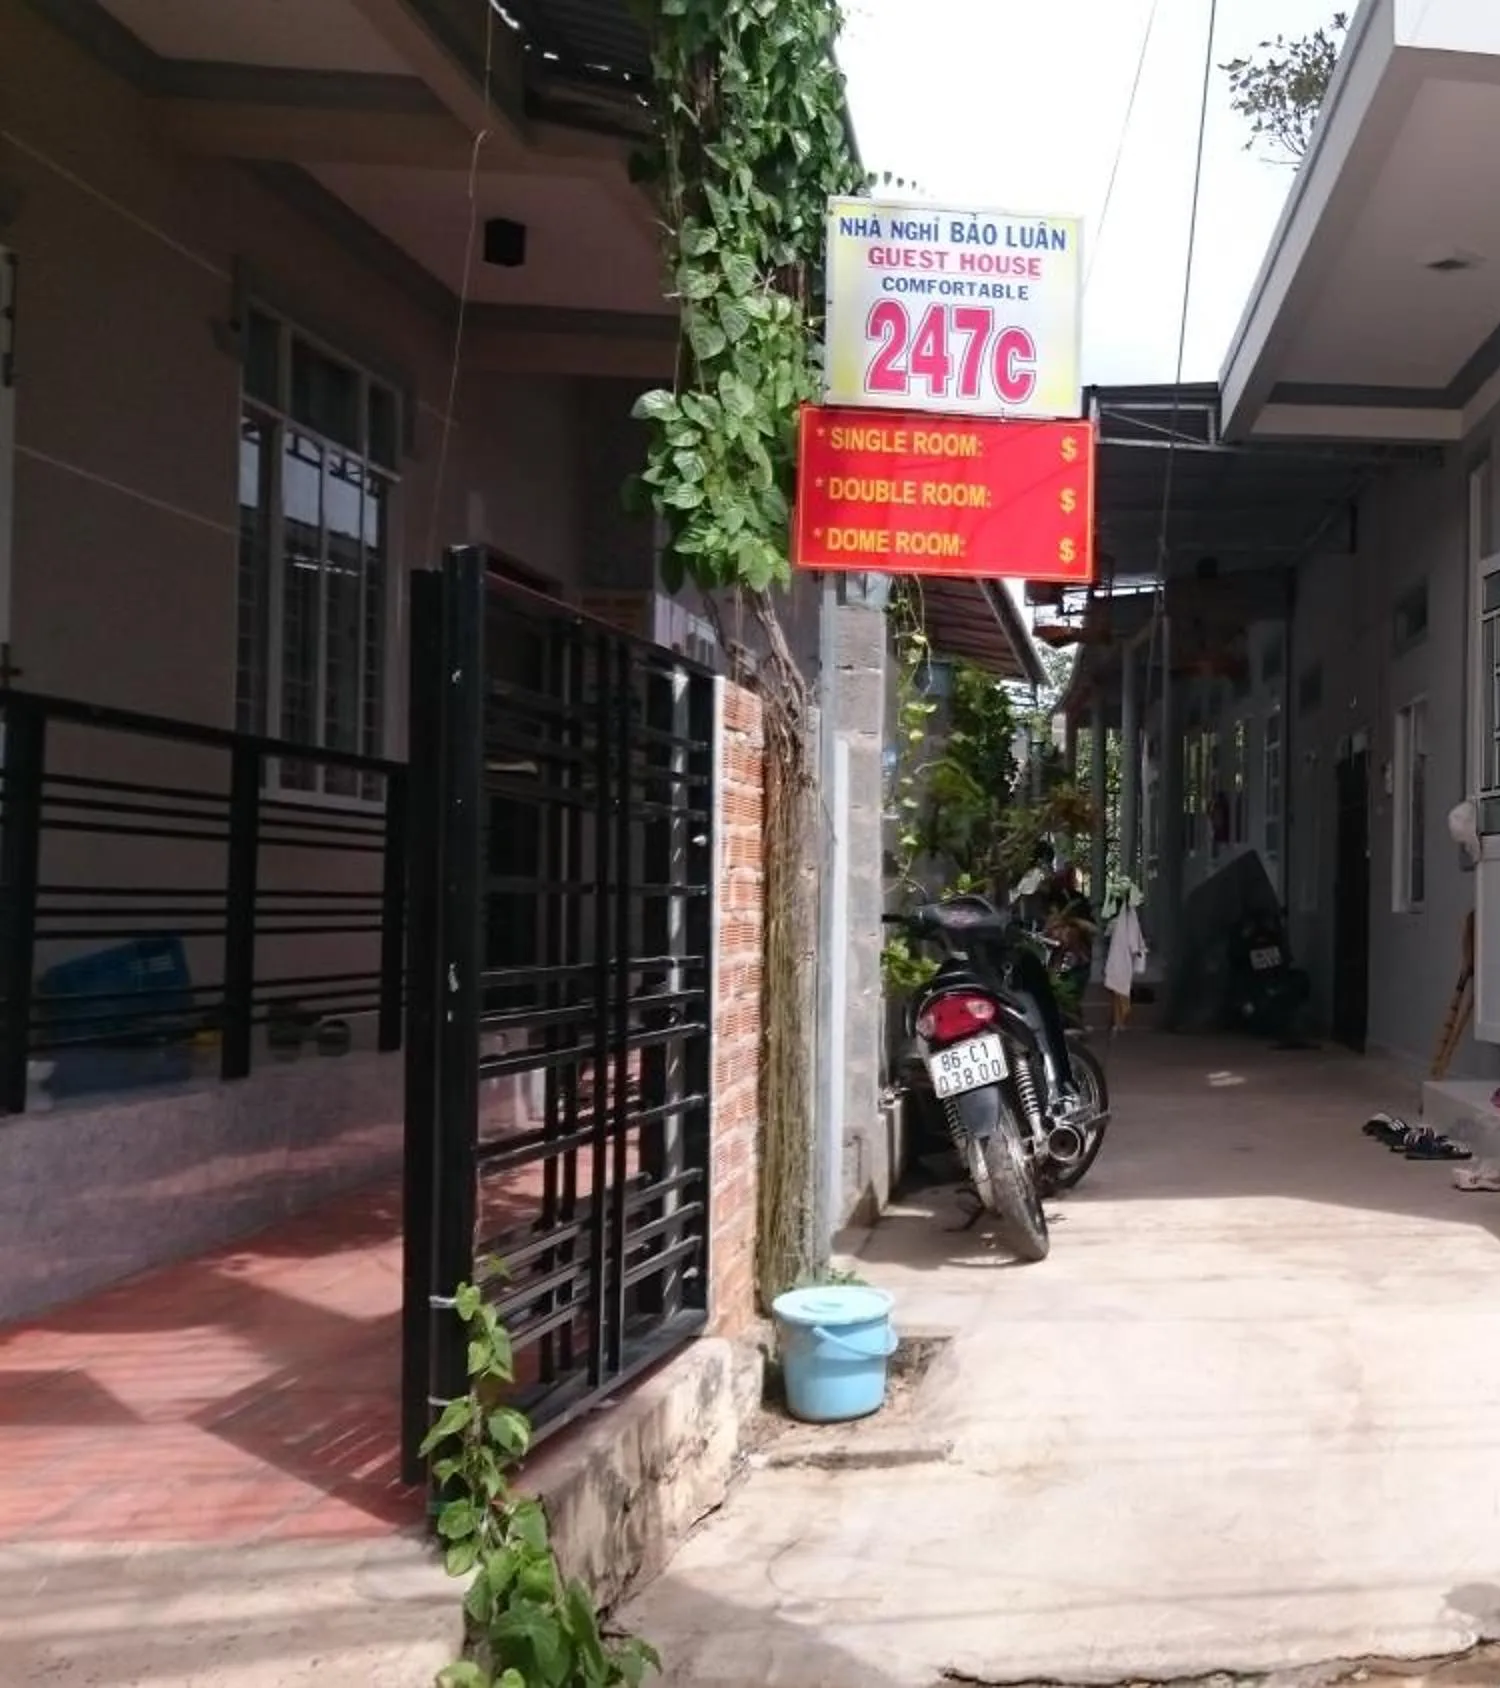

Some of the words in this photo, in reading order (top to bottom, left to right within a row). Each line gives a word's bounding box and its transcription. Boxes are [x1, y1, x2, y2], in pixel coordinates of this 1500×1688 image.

[1006, 221, 1066, 251] LUÂN
[868, 246, 949, 270] GUEST
[959, 252, 1042, 277] HOUSE
[882, 275, 1030, 301] COMFORTABLE
[830, 427, 908, 454] SINGLE
[913, 431, 983, 457] ROOM:
[1060, 436, 1078, 463] $
[828, 477, 916, 505] DOUBLE
[921, 481, 992, 508] ROOM:
[1059, 488, 1077, 514] $
[826, 527, 890, 554] DOME
[895, 531, 966, 557] ROOM:
[1059, 539, 1077, 563] $
